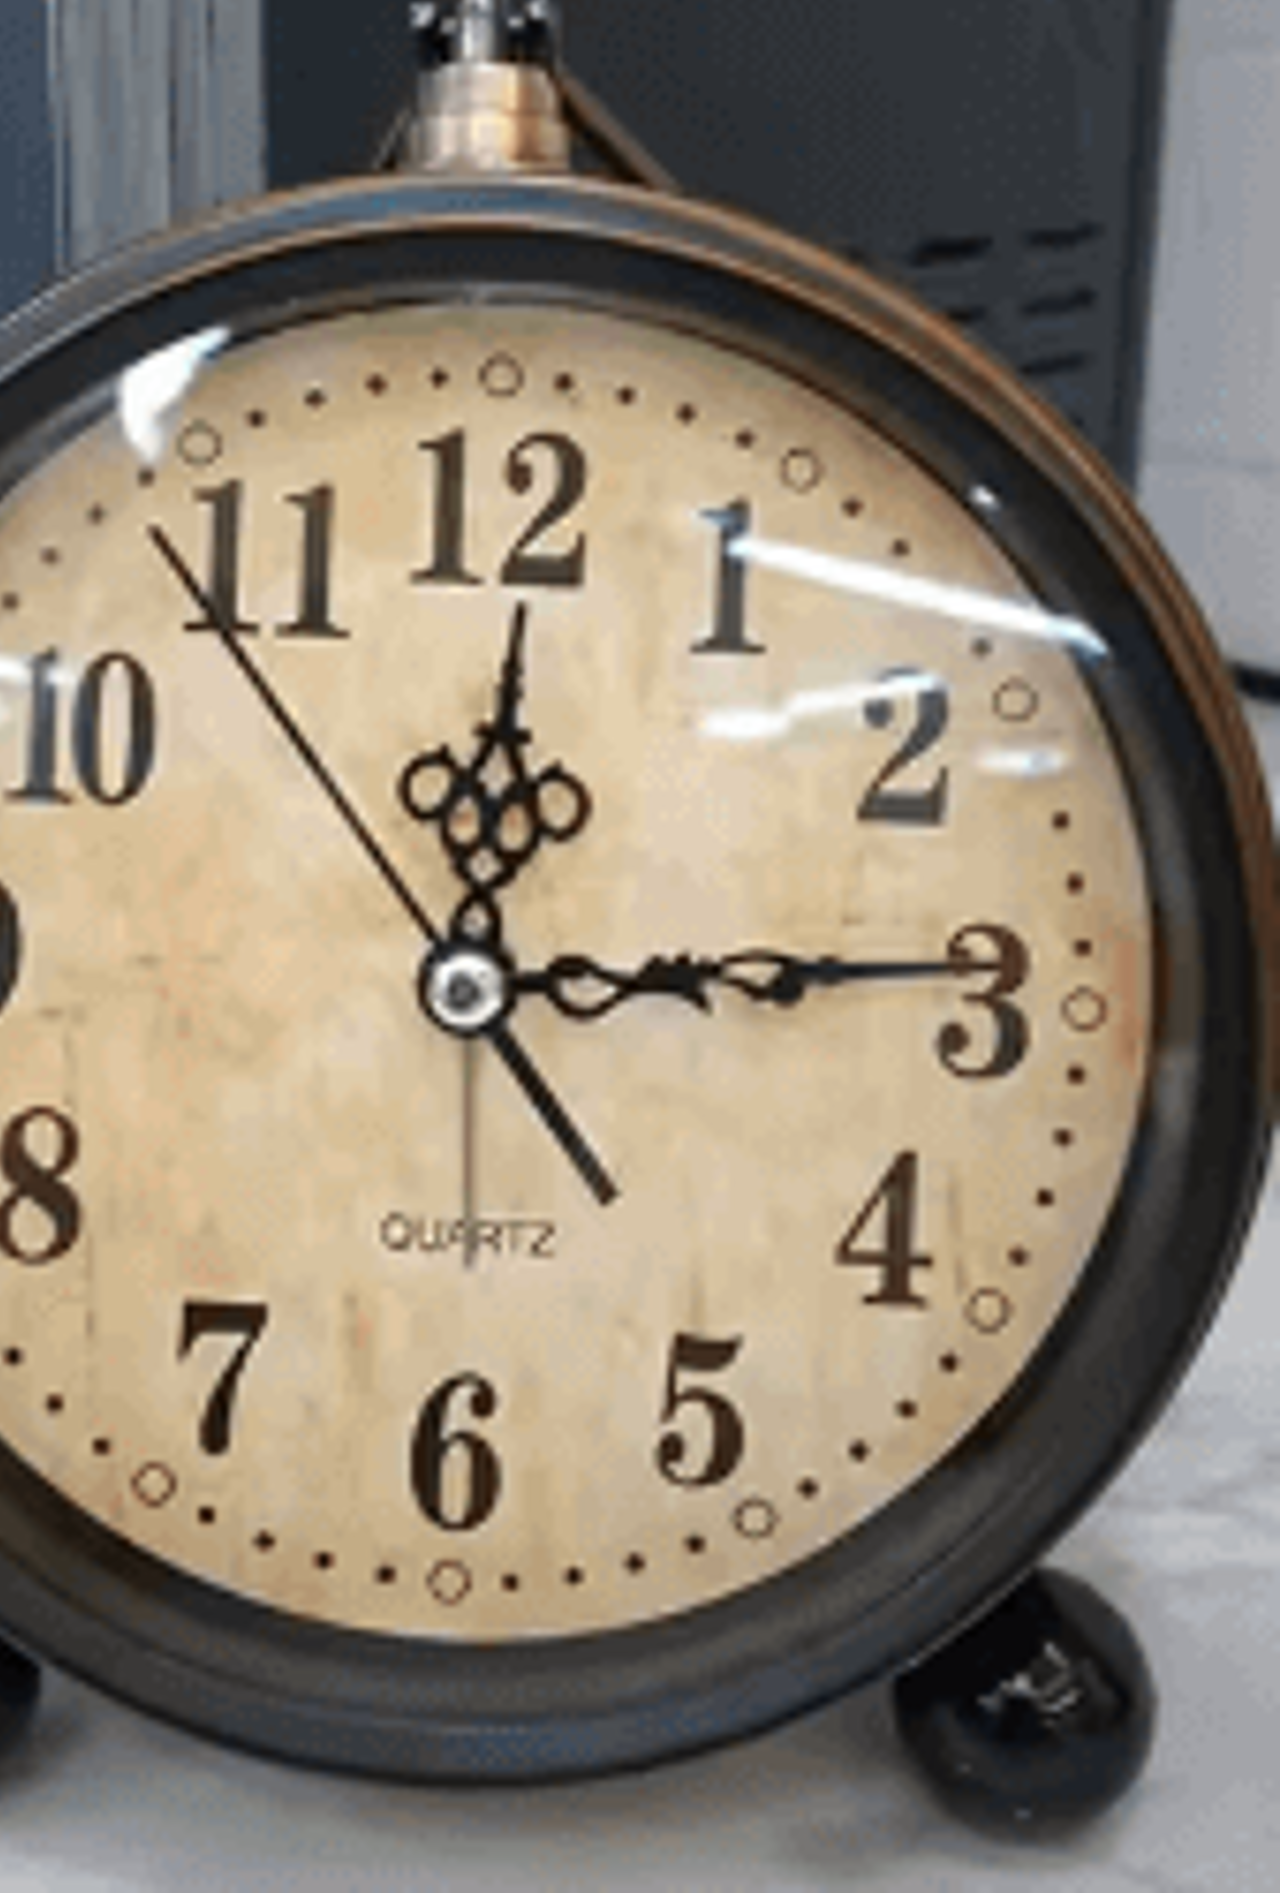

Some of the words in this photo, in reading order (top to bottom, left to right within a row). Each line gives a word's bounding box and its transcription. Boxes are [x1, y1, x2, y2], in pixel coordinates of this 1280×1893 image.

[182, 477, 352, 639] 11
[409, 429, 590, 590] 12
[689, 500, 766, 655] 1
[4, 646, 158, 807] 10
[857, 668, 950, 826] 2
[934, 923, 1031, 1079] 3
[379, 1213, 559, 1260] QUARTZ
[834, 1150, 933, 1307] 4
[176, 1298, 270, 1457] 7
[409, 1372, 500, 1532] 6
[655, 1332, 745, 1487] 5
